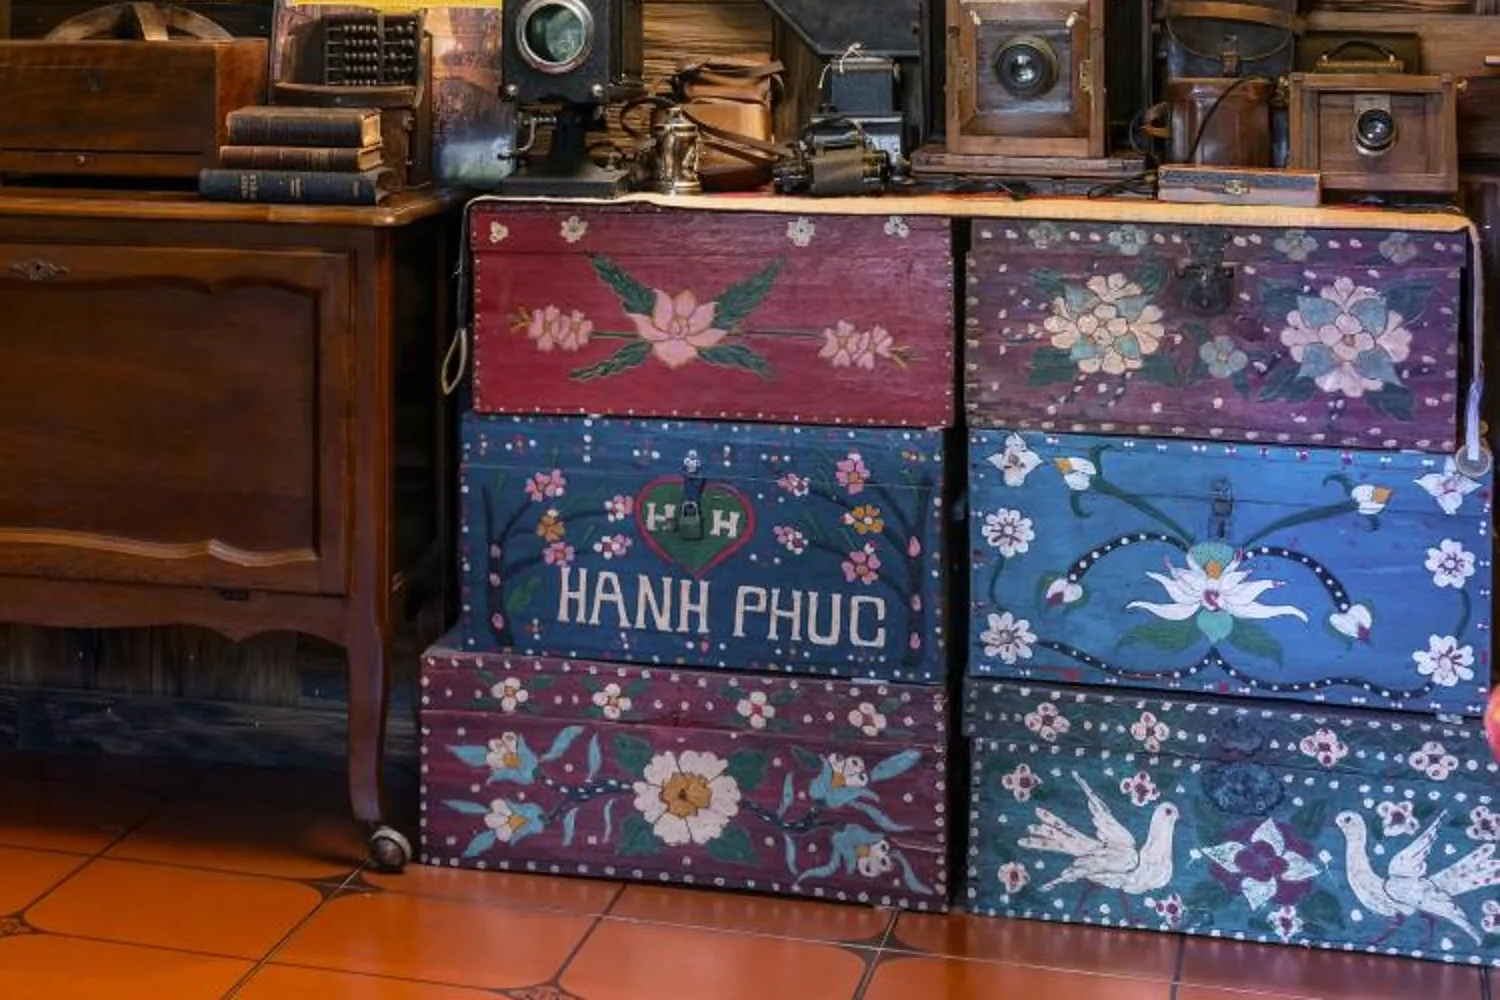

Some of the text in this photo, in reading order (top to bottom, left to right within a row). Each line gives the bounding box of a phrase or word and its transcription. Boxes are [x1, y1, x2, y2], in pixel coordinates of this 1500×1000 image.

[645, 503, 741, 539] H H
[557, 566, 887, 649] HANH PHUC
